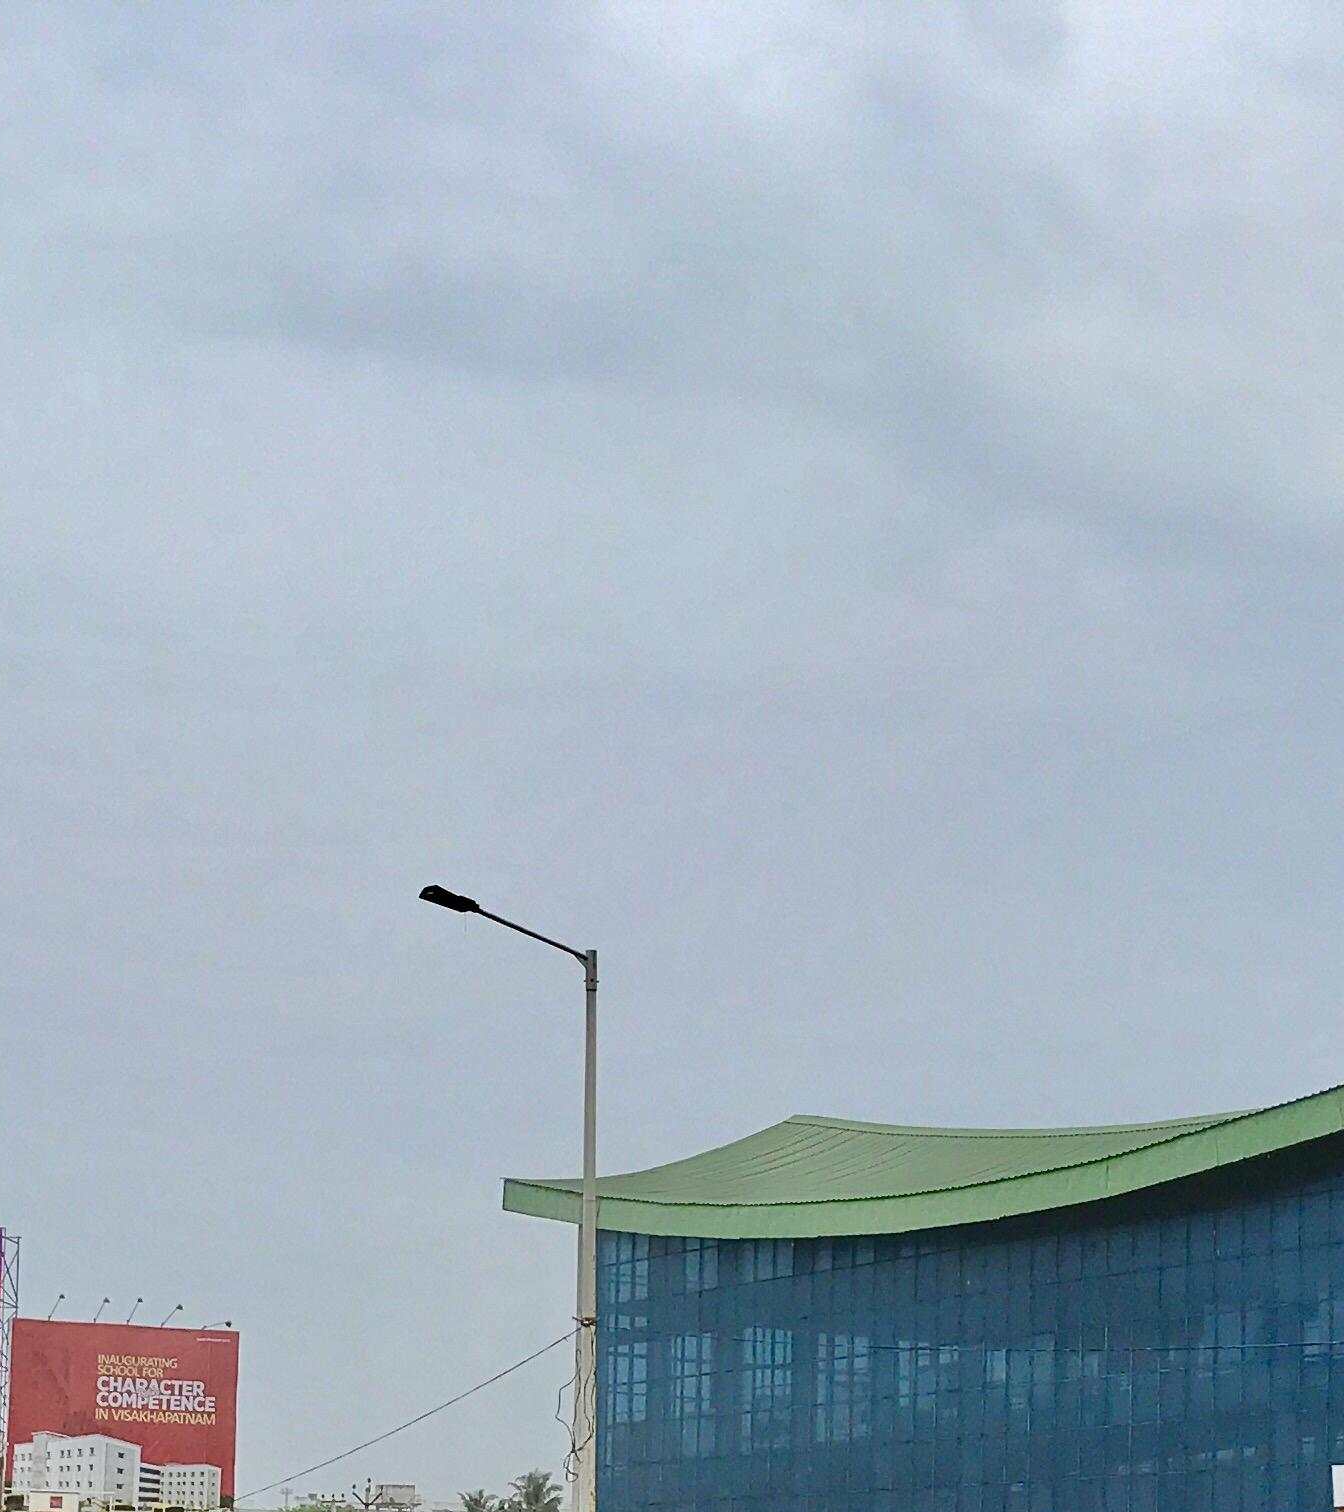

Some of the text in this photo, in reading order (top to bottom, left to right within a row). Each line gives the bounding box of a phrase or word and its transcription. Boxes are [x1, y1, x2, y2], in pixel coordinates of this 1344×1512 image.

[97, 1354, 178, 1369] INAUGURATING
[97, 1365, 164, 1379] SCHOOL FOR
[96, 1376, 205, 1397] CHARACTER
[96, 1391, 216, 1413] COMPETENCE
[95, 1408, 216, 1425] IN VISAKHAPATNAM
